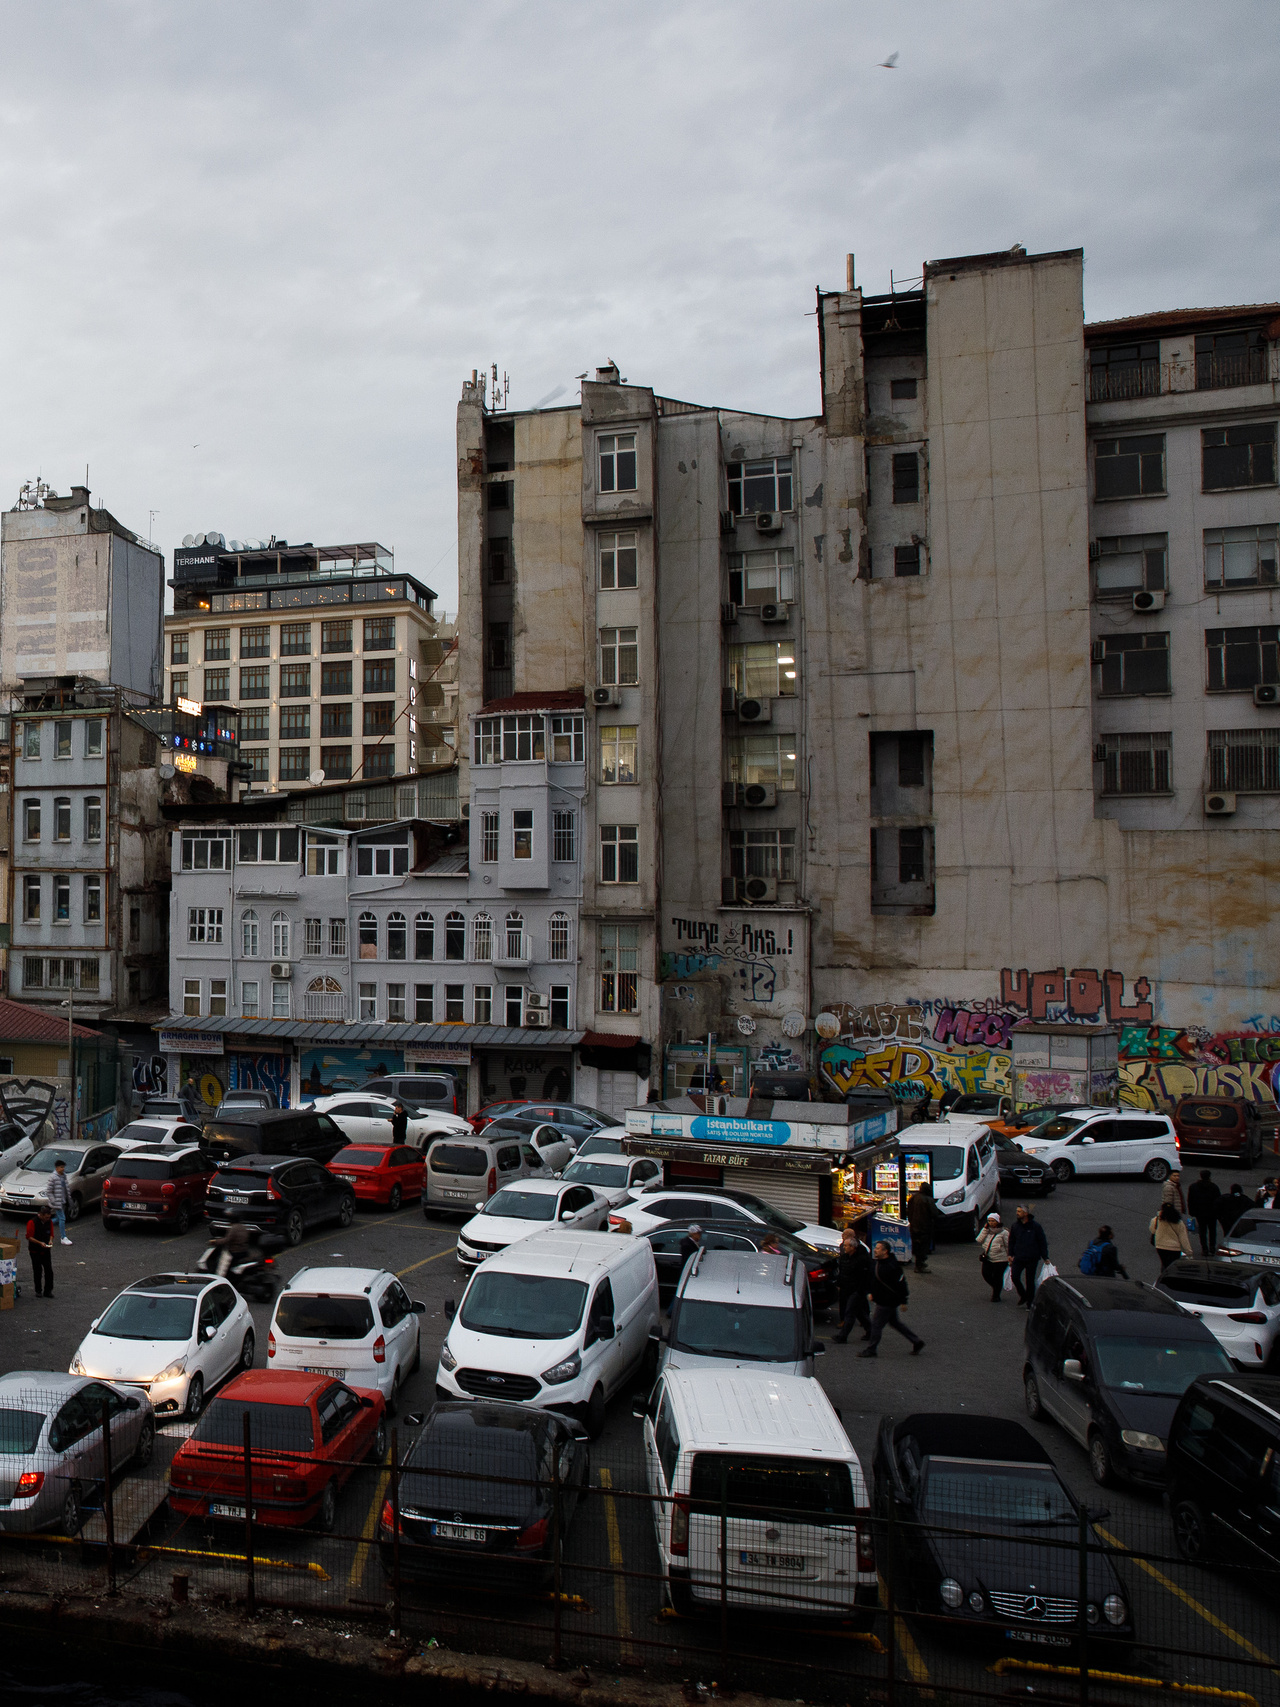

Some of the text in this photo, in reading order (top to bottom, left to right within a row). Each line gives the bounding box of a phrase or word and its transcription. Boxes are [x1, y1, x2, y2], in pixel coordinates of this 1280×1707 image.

[176, 556, 215, 566] TERSHANE
[161, 1031, 199, 1041] ARMAĞAN
[201, 1033, 222, 1041] BOYA
[448, 1042, 469, 1051] BOYA
[706, 1118, 774, 1132] istanbulkart
[703, 1153, 749, 1166] TATAR BÜFE
[436, 1525, 447, 1535] 34
[474, 1530, 485, 1540] 66
[748, 1554, 759, 1564] 34
[779, 1557, 801, 1569] 9804
